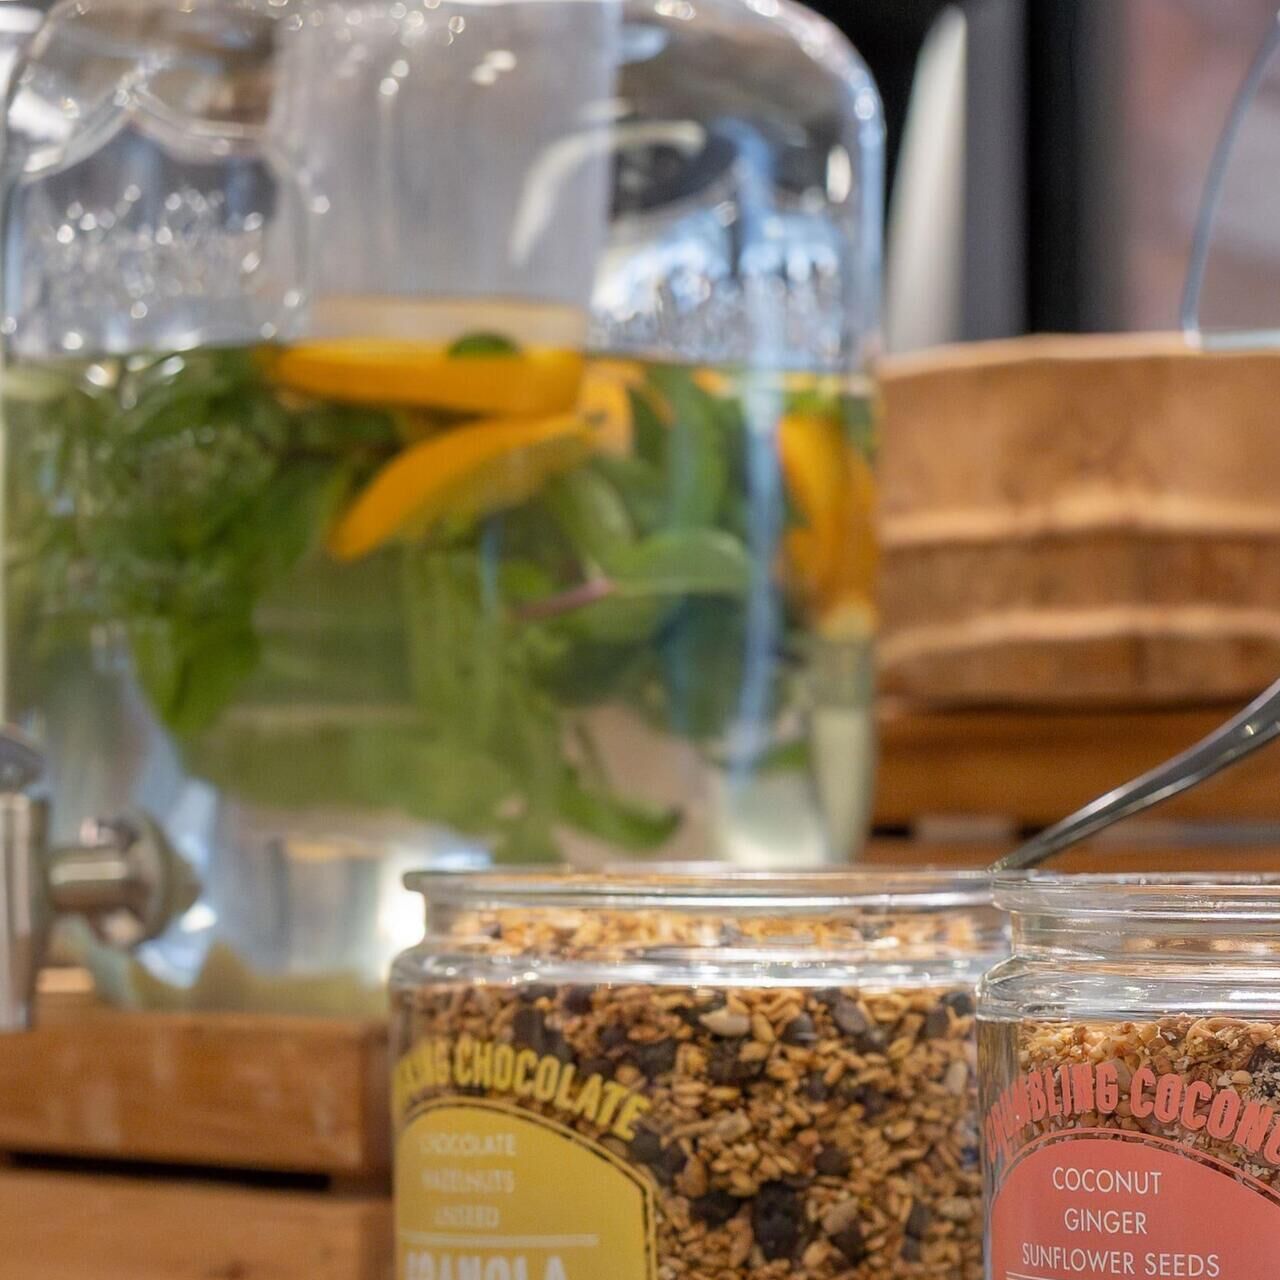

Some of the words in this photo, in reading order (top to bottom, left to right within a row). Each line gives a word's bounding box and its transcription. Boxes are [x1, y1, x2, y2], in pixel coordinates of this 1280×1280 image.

[455, 1033, 650, 1141] CHOCOLATE
[1052, 1166, 1162, 1195] COCONUT
[1063, 1207, 1148, 1235] GINGER
[1022, 1243, 1135, 1275] SUNFLOWER
[1144, 1253, 1220, 1277] SEEDS
